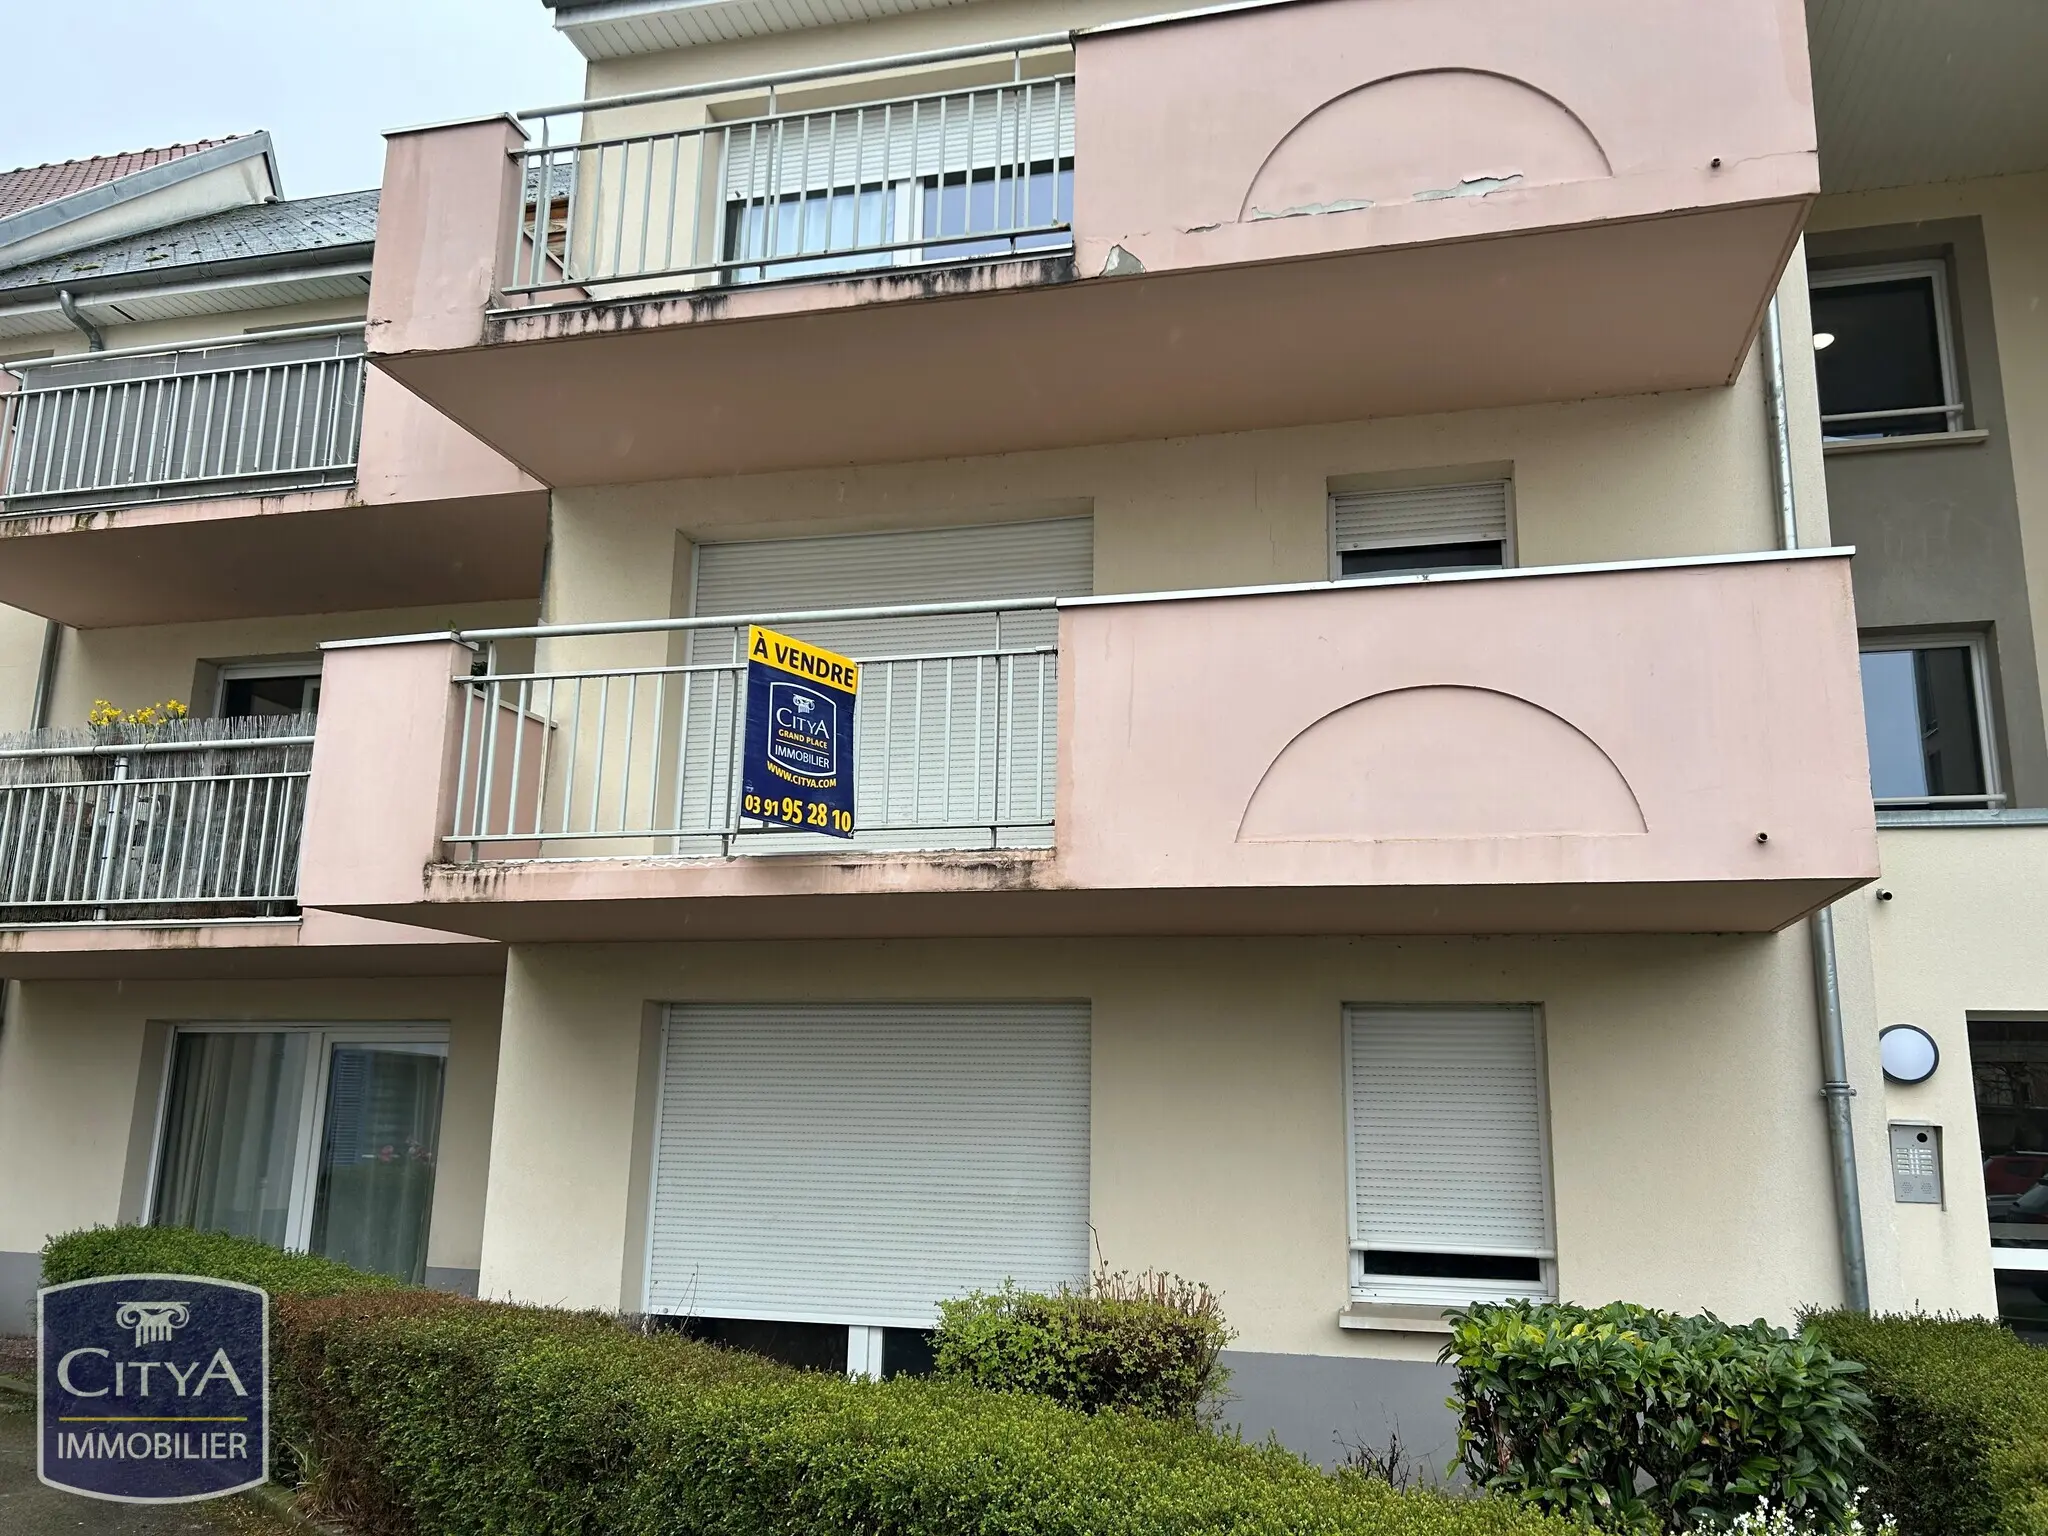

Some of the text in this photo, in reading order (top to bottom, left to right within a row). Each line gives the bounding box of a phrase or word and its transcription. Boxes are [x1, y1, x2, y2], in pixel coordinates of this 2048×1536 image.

[753, 631, 854, 688] À VENDRE
[778, 729, 828, 749] GRAND PLACE
[775, 745, 829, 768] IMMOBILIER
[767, 760, 837, 788] WWW.CITYA.COM
[745, 794, 852, 832] 03 91 95 28 10
